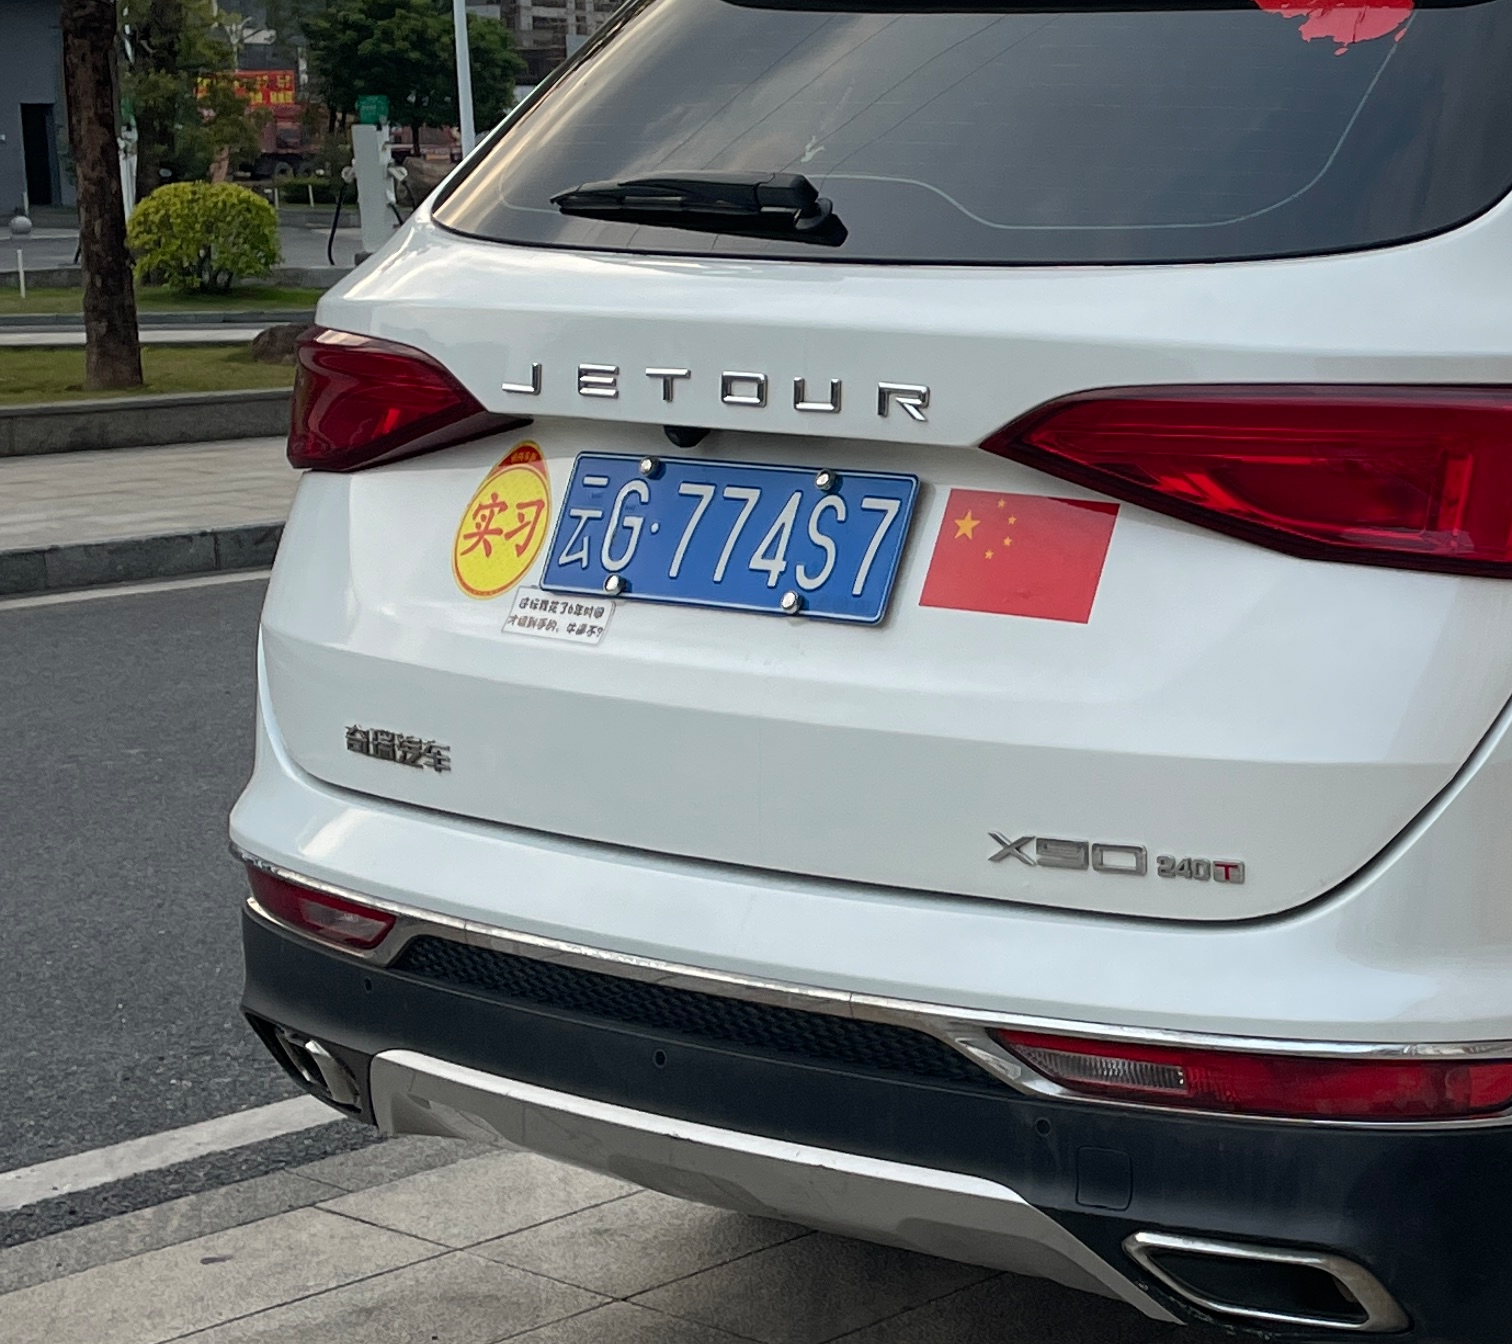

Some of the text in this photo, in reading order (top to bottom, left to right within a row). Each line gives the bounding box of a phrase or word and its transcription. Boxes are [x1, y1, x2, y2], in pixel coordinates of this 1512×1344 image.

[501, 361, 931, 422] JETOUR
[460, 492, 546, 558] 实习
[987, 830, 1246, 886] X90 240T
